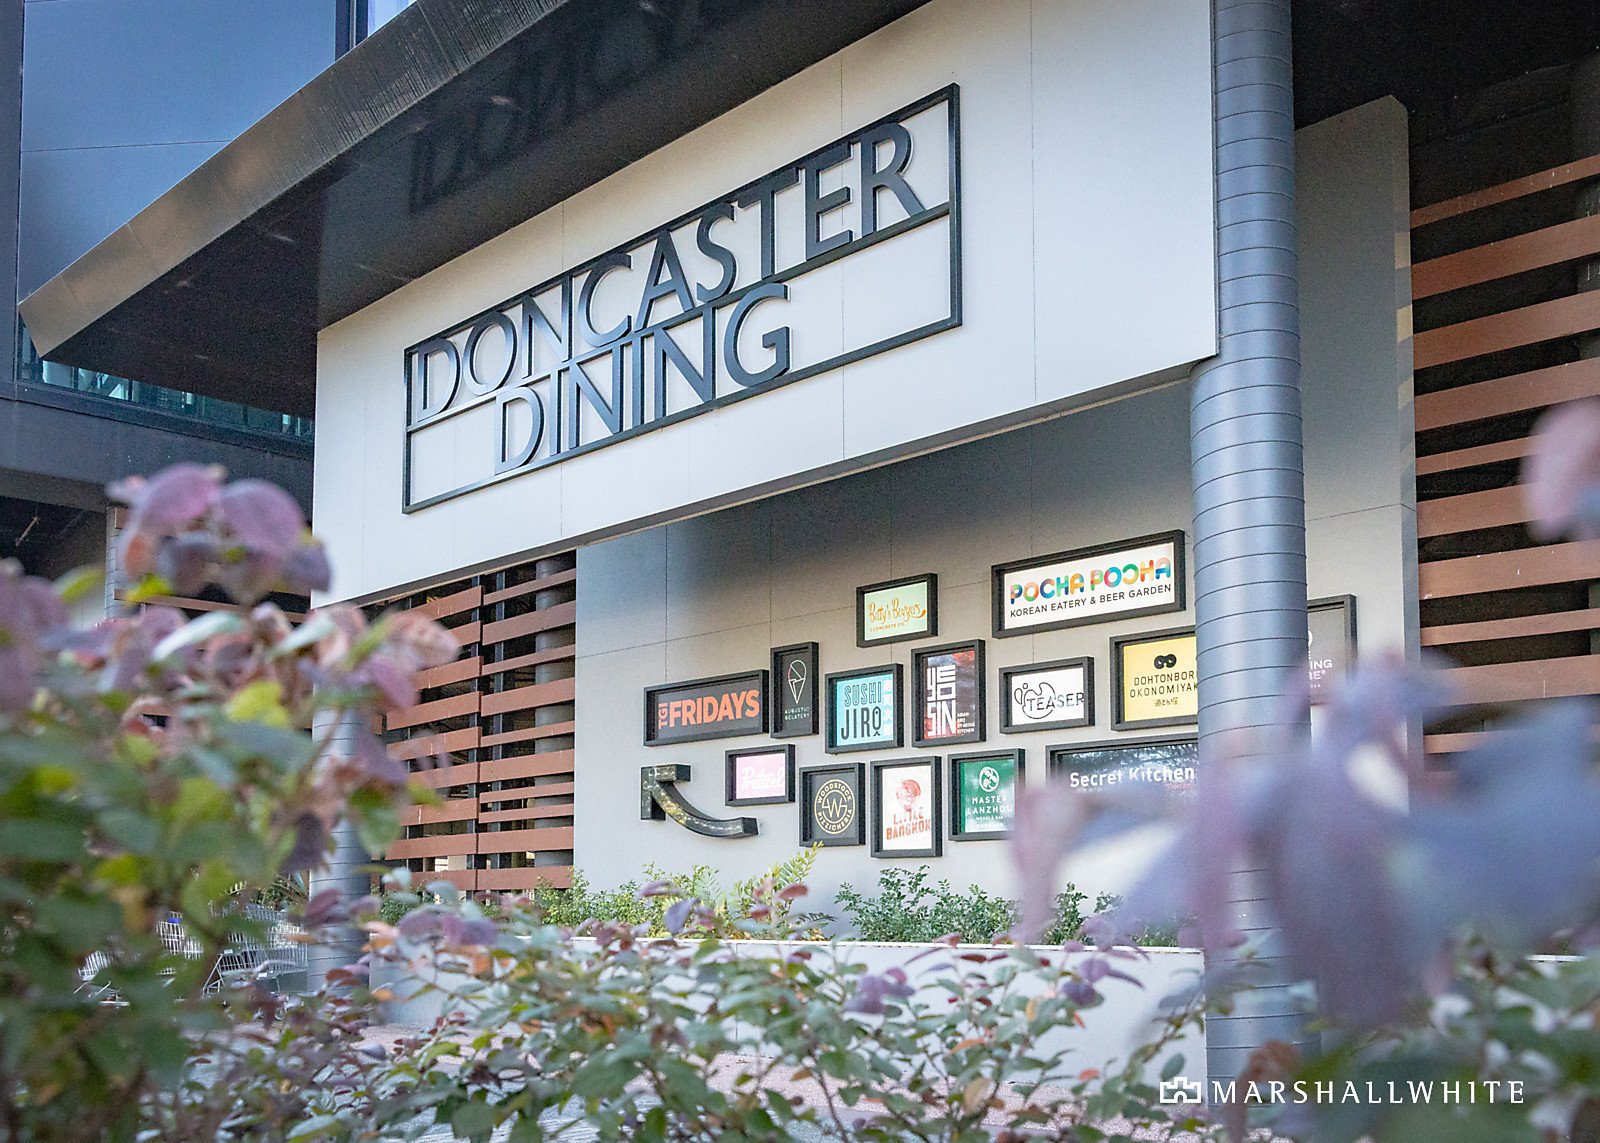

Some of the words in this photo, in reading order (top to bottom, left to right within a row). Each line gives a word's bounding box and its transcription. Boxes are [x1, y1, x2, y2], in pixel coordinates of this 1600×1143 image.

[415, 121, 927, 423] DONCASTER
[494, 282, 791, 476] DINING
[1009, 573, 1085, 605] POCHA
[1010, 604, 1048, 618] KOREAN
[1051, 598, 1087, 611] EATERY
[1089, 596, 1097, 605] &
[1099, 591, 1125, 603] BEER
[1128, 583, 1172, 598] GARDEN
[1134, 670, 1196, 686] DOHTONBOR
[844, 681, 882, 707] SUSHI
[1026, 691, 1084, 712] TEASER
[1129, 682, 1199, 698] OKONOMIYAK
[658, 702, 668, 729] TGI
[669, 689, 760, 727] FRIDAYS
[1069, 770, 1123, 788] Secret
[1129, 765, 1195, 782] Kitchen
[817, 782, 852, 804] WOODSTOCK
[972, 795, 1007, 804] MASTER
[817, 809, 853, 832] PIZZICHERIA
[967, 805, 1013, 815] LANZHOU
[886, 818, 931, 841] BANGKOK
